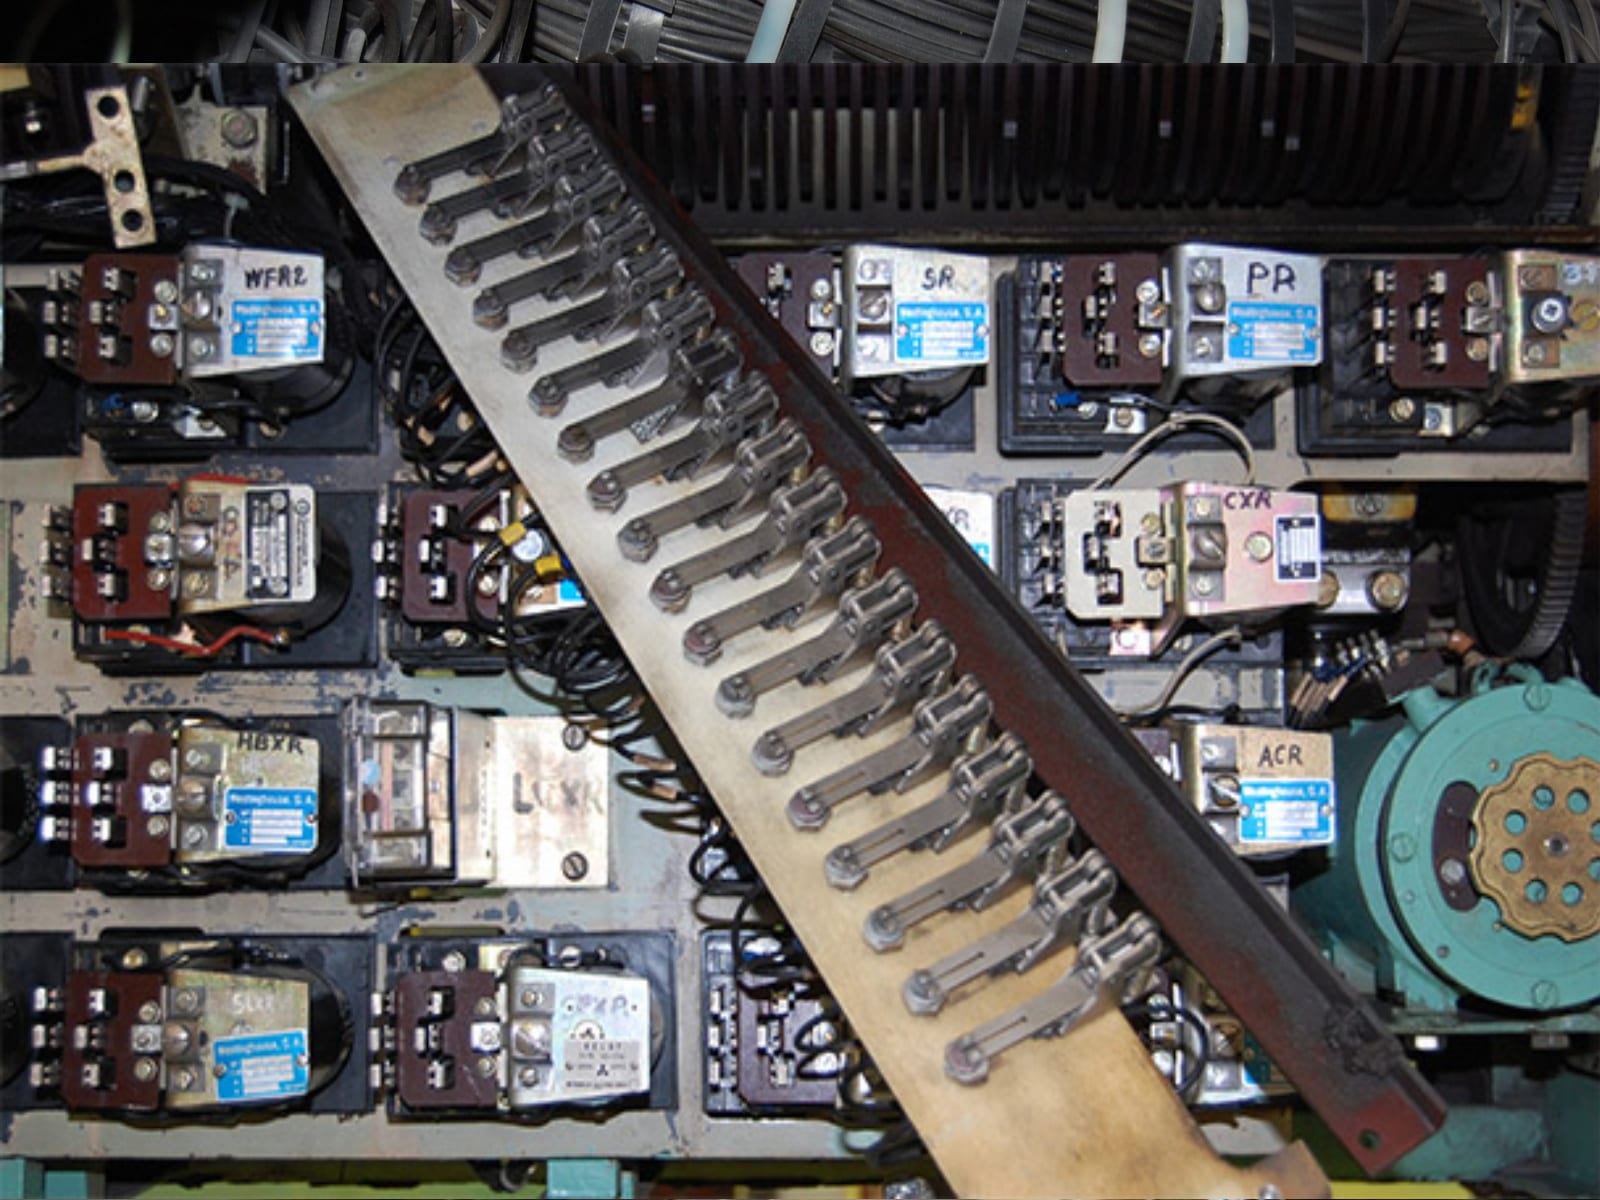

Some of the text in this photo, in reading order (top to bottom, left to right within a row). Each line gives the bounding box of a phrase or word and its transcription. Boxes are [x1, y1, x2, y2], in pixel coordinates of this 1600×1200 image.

[921, 264, 956, 291] SR
[1246, 261, 1296, 294] PR
[1224, 490, 1271, 509] CXR
[1257, 744, 1303, 768] ACR
